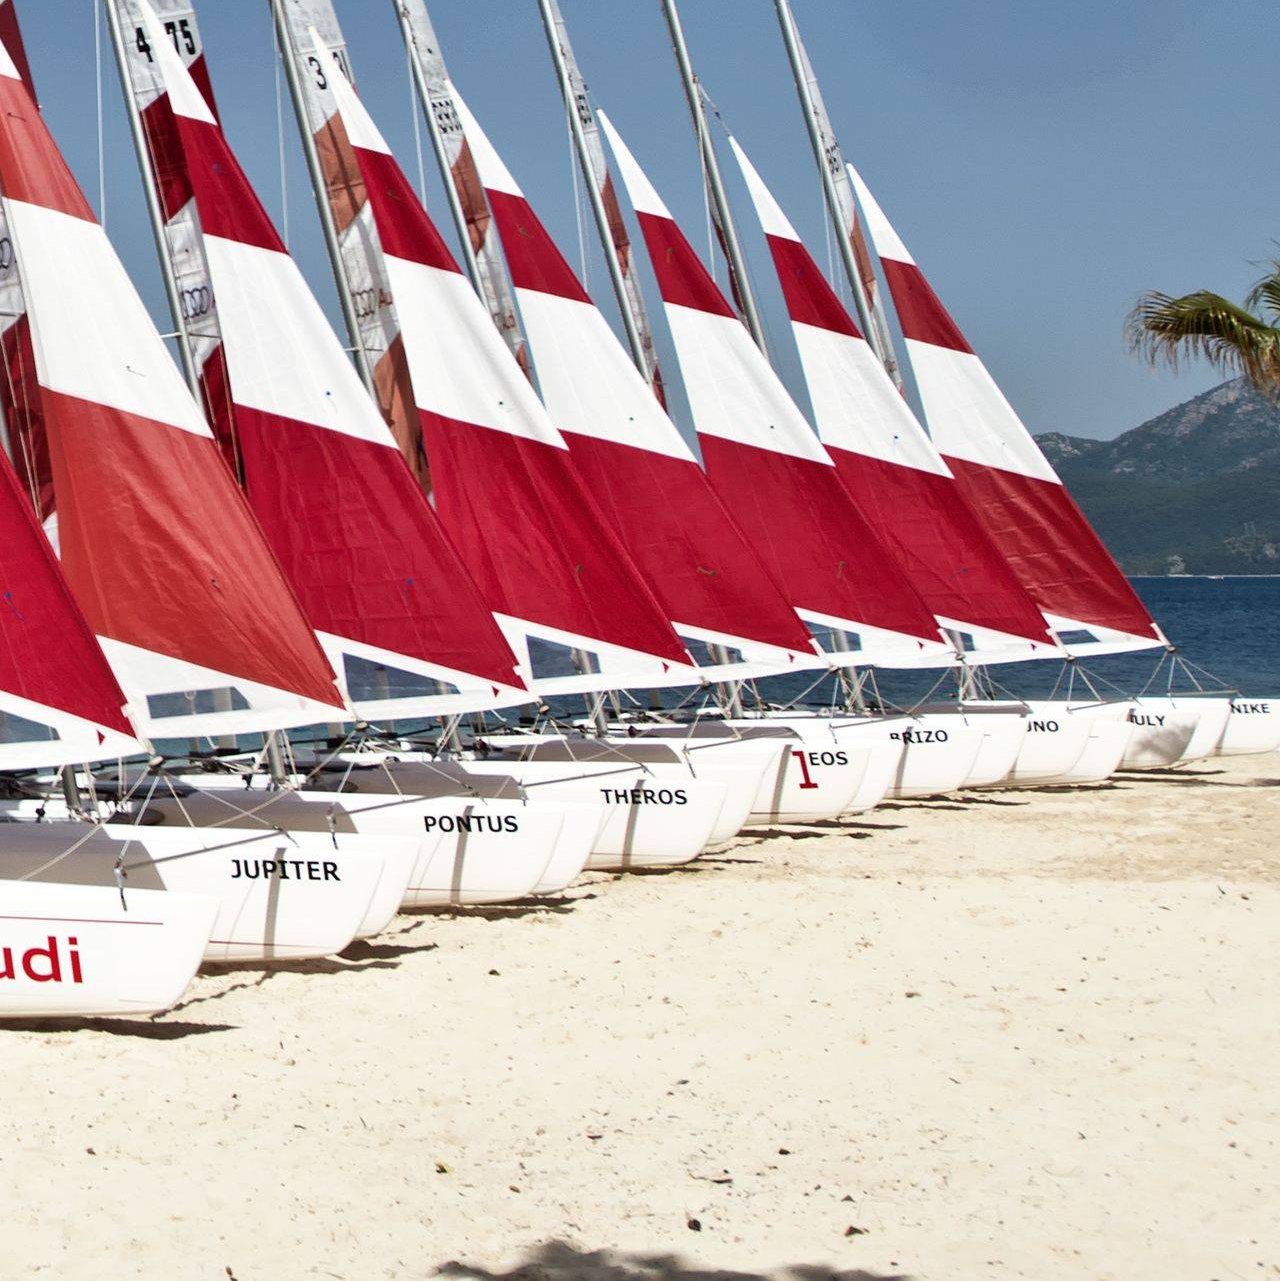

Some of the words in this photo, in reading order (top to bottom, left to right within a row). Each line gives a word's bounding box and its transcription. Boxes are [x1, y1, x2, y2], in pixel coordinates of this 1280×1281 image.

[135, 18, 196, 63] 475
[1229, 703, 1271, 714] NIKE
[809, 751, 848, 766] EOS
[600, 789, 688, 805] THEROS
[424, 815, 519, 833] PONTUS
[231, 859, 342, 881] JUPITER
